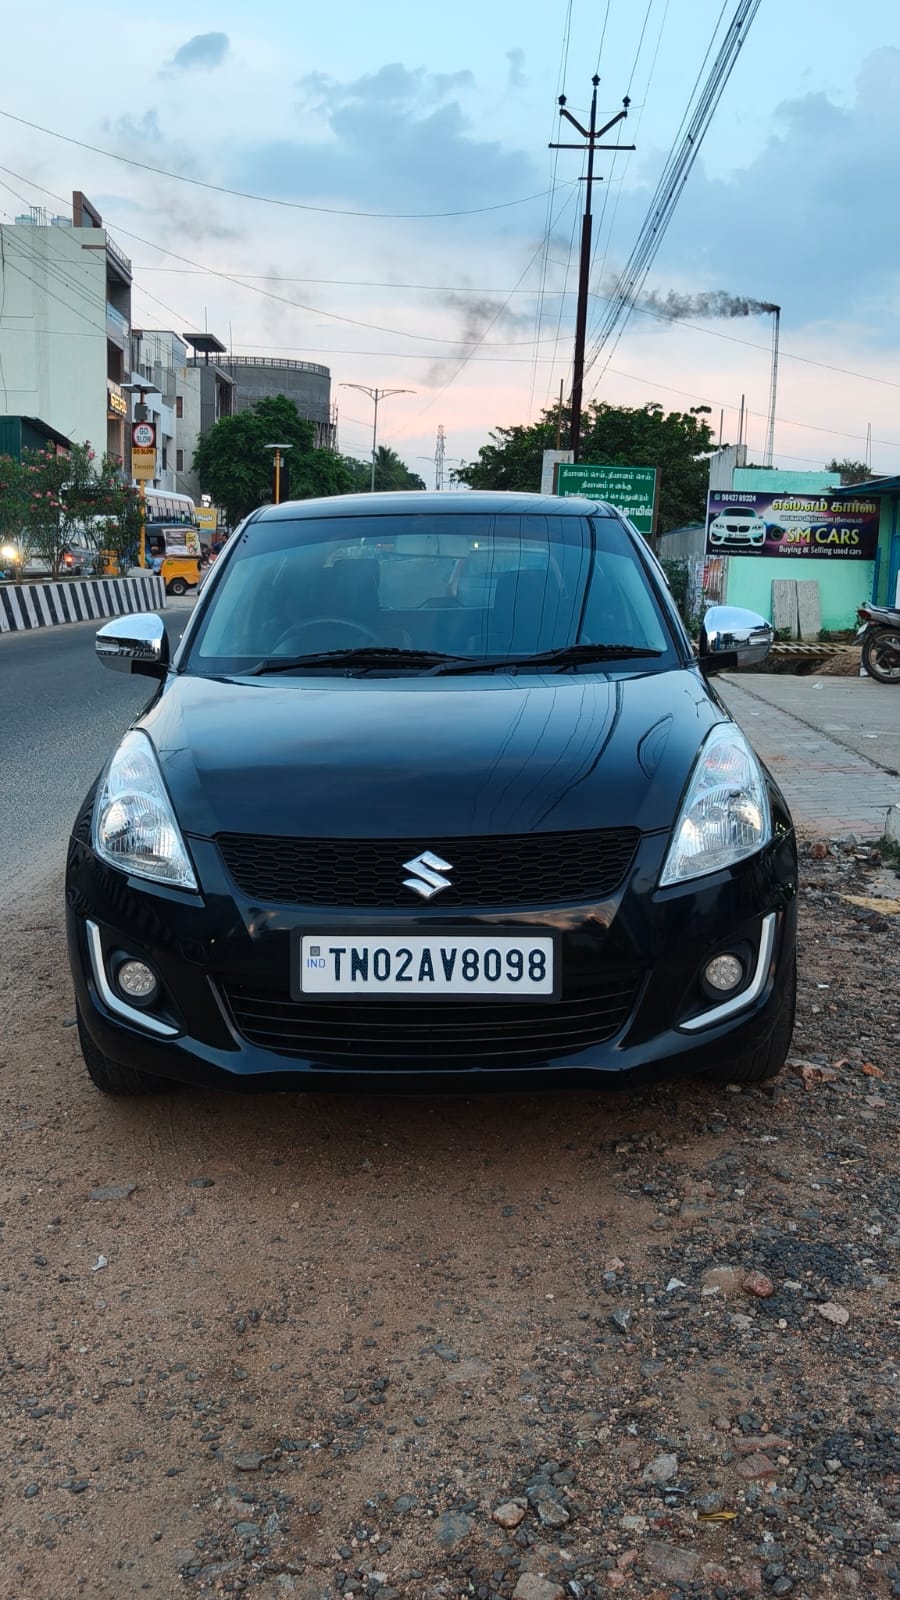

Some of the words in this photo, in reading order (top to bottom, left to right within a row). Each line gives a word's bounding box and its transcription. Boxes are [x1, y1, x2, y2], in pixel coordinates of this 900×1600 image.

[136, 435, 152, 443] SLOW
[786, 527, 811, 543] SM
[815, 527, 860, 545] CARS
[779, 545, 801, 554] Buying
[810, 546, 832, 555] Selling
[833, 547, 848, 555] used
[306, 958, 326, 969] IND
[328, 947, 546, 982] TN02AV8098
